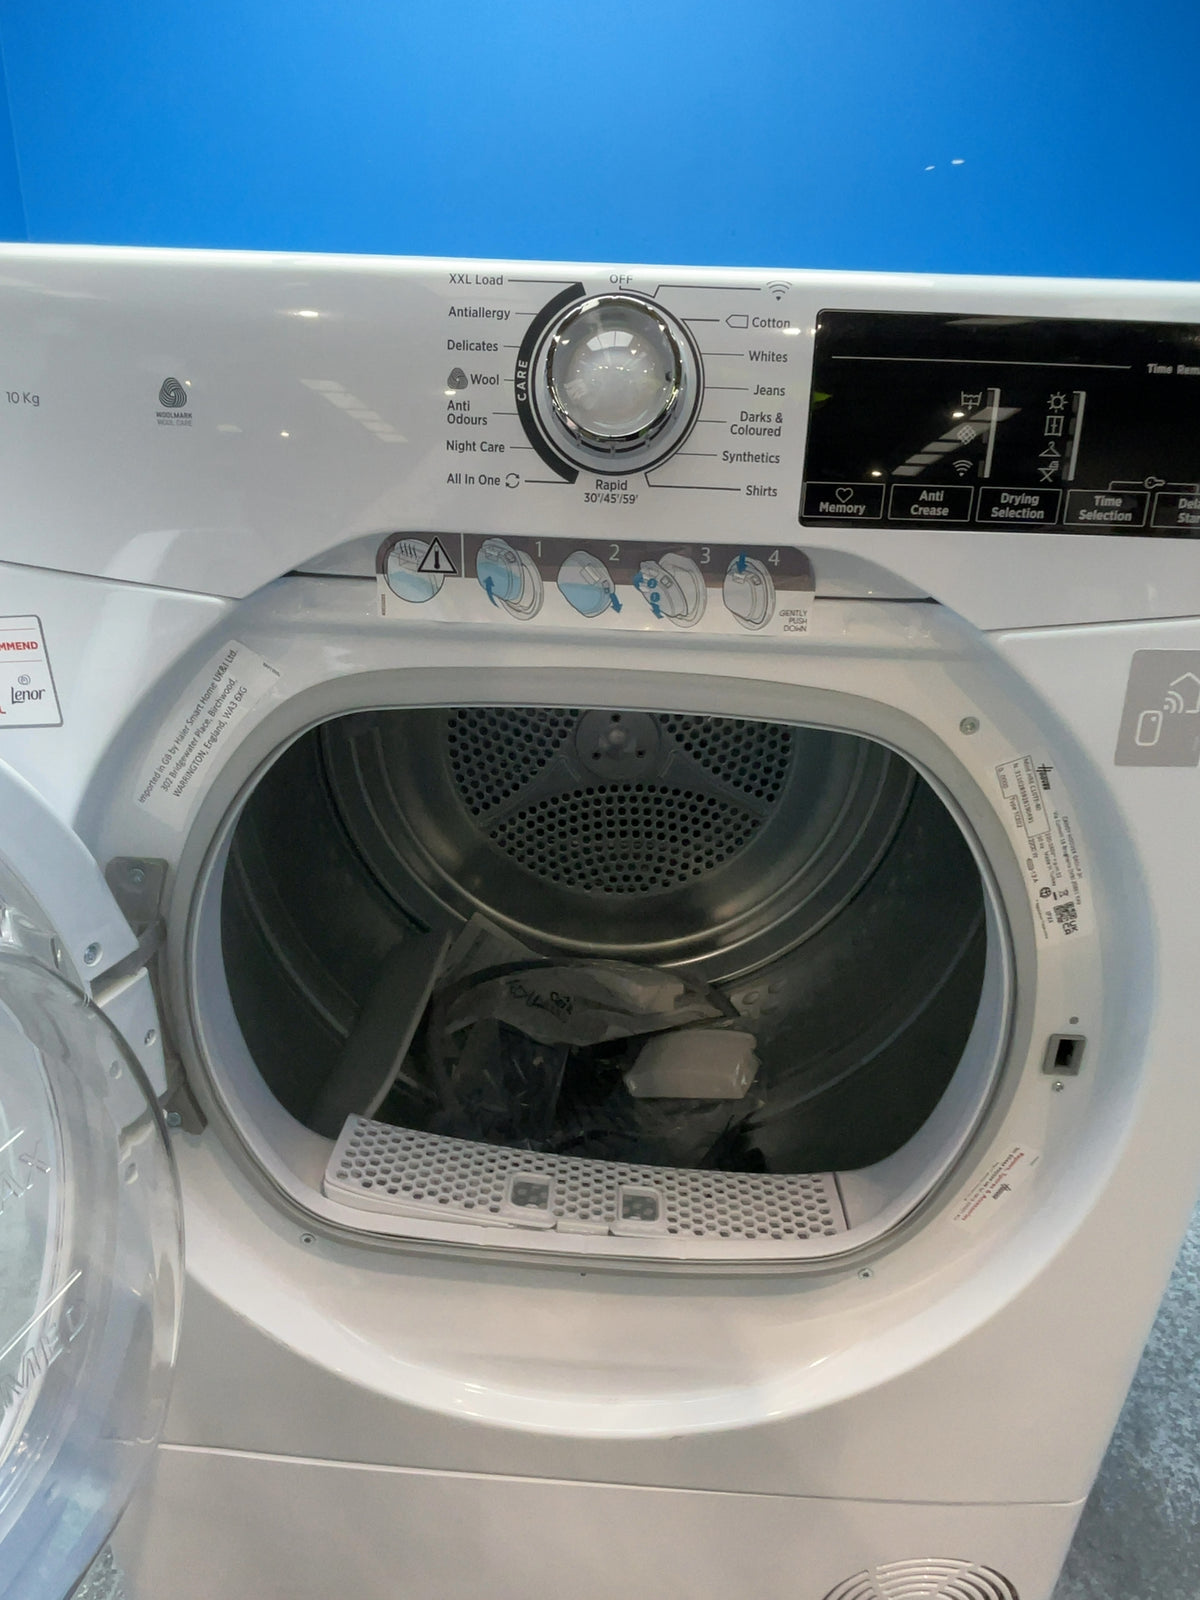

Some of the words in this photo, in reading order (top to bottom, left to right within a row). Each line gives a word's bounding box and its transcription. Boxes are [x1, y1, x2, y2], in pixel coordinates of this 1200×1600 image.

[449, 273, 472, 285] XXL
[475, 274, 504, 285] Load
[609, 274, 633, 284] OFF
[448, 306, 510, 320] Antiallergy
[752, 317, 791, 328] Cotton
[447, 339, 499, 352] Delicates
[749, 350, 788, 363] Whites
[1147, 363, 1173, 374] Time
[470, 374, 499, 385] Wool
[516, 360, 529, 402] CARE
[753, 384, 786, 396] Jeans
[6, 391, 20, 404] 10
[23, 391, 40, 407] Kg
[447, 400, 471, 411] Anti
[156, 411, 192, 419] WOOLMARK
[447, 413, 488, 425] Odours
[740, 411, 772, 423] Darks
[775, 412, 783, 423] &
[730, 424, 782, 437] Coloured
[446, 440, 477, 453] Night
[480, 441, 505, 452] Care
[722, 450, 780, 464] Synthetics
[447, 473, 461, 484] All
[465, 474, 475, 484] In
[478, 474, 501, 485] One
[595, 479, 628, 492] Rapid
[746, 485, 778, 497] Shirts
[919, 490, 944, 501] Anti
[1000, 492, 1040, 506] Drying
[1094, 495, 1123, 507] Time
[819, 502, 866, 515] Memory
[910, 504, 949, 516] Crease
[991, 507, 1045, 519] Selection
[1078, 509, 1133, 522] Selection
[535, 541, 542, 558] 1
[608, 544, 620, 560] 2
[700, 547, 711, 564] 3
[768, 549, 780, 566] 4
[779, 609, 807, 617] GENTLY
[783, 624, 807, 632] DOWN
[213, 662, 229, 683] UK&I
[11, 686, 46, 704] Lenor
[199, 682, 218, 705] Home
[186, 703, 203, 726] Smart
[175, 725, 189, 745] Haier
[173, 748, 209, 798] WARRINGTON,
[204, 721, 228, 749] England,
[223, 700, 238, 719] WA3
[234, 686, 248, 702] 6XG
[167, 745, 180, 757] by
[161, 778, 173, 792] 302
[169, 737, 199, 780] Bridgewater
[162, 753, 173, 766] GB
